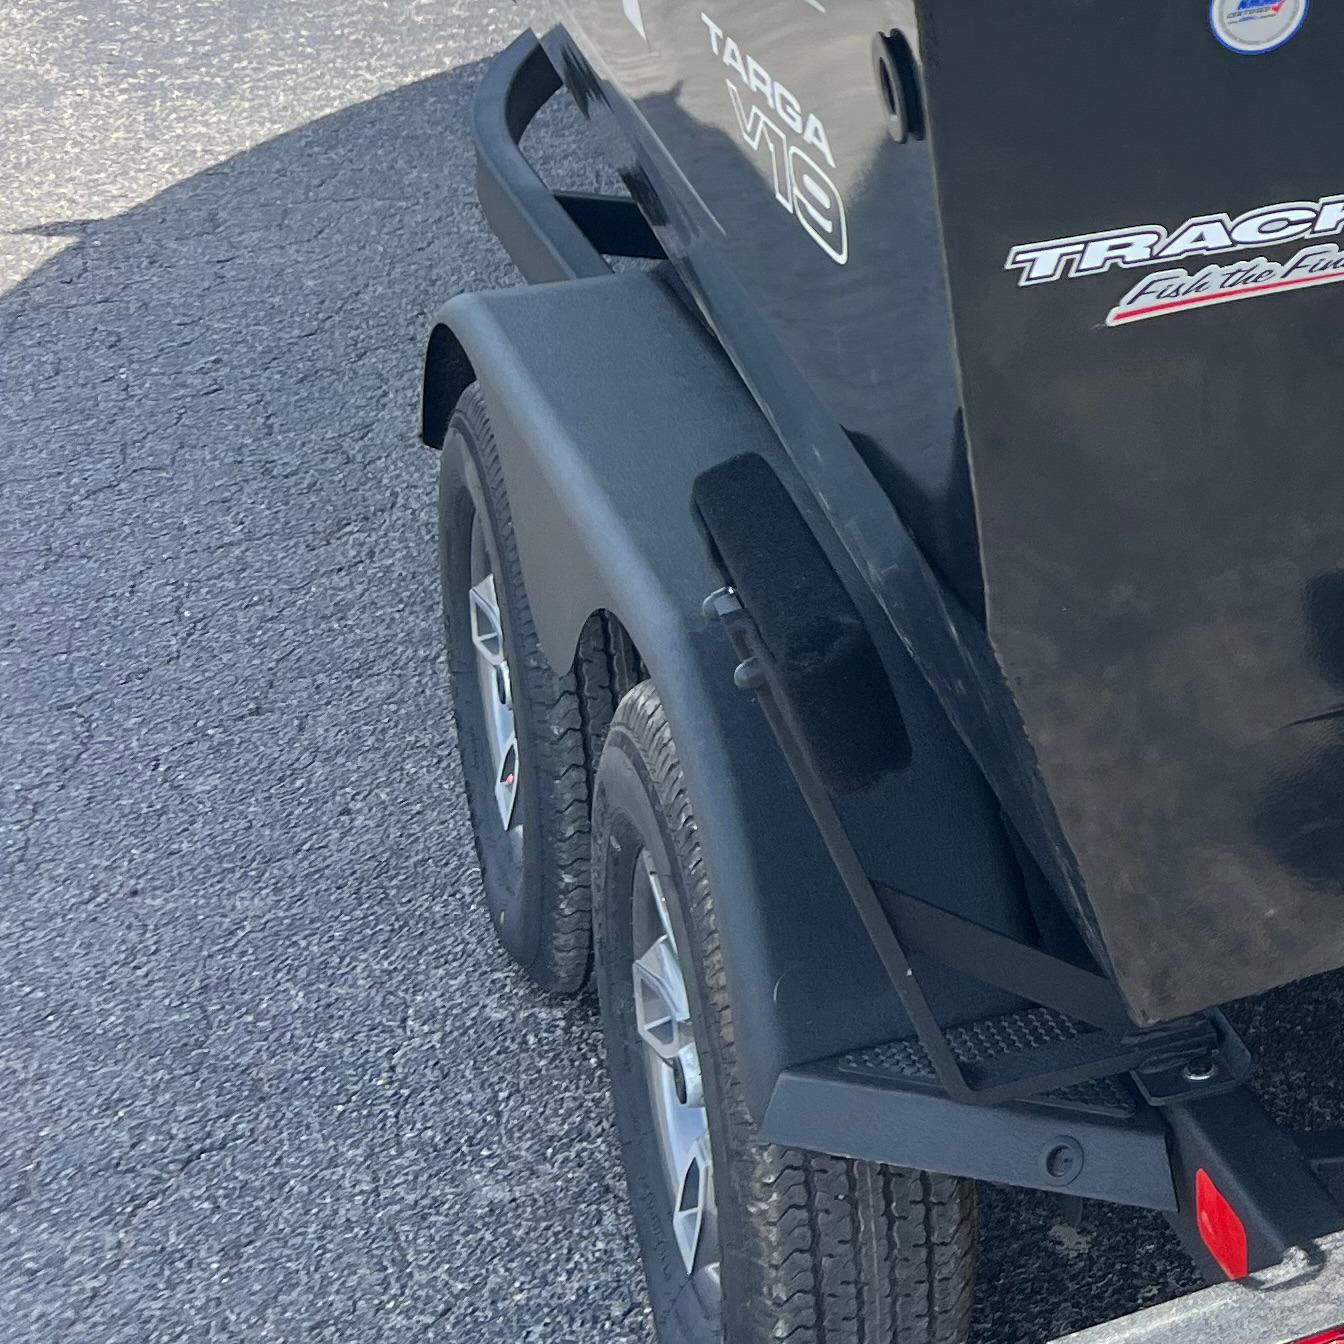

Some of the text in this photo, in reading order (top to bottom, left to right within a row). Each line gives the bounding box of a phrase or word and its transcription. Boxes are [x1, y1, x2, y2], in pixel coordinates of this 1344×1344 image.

[700, 11, 837, 169] TARGA
[1126, 269, 1212, 306] Fish
[1219, 263, 1276, 291] the
